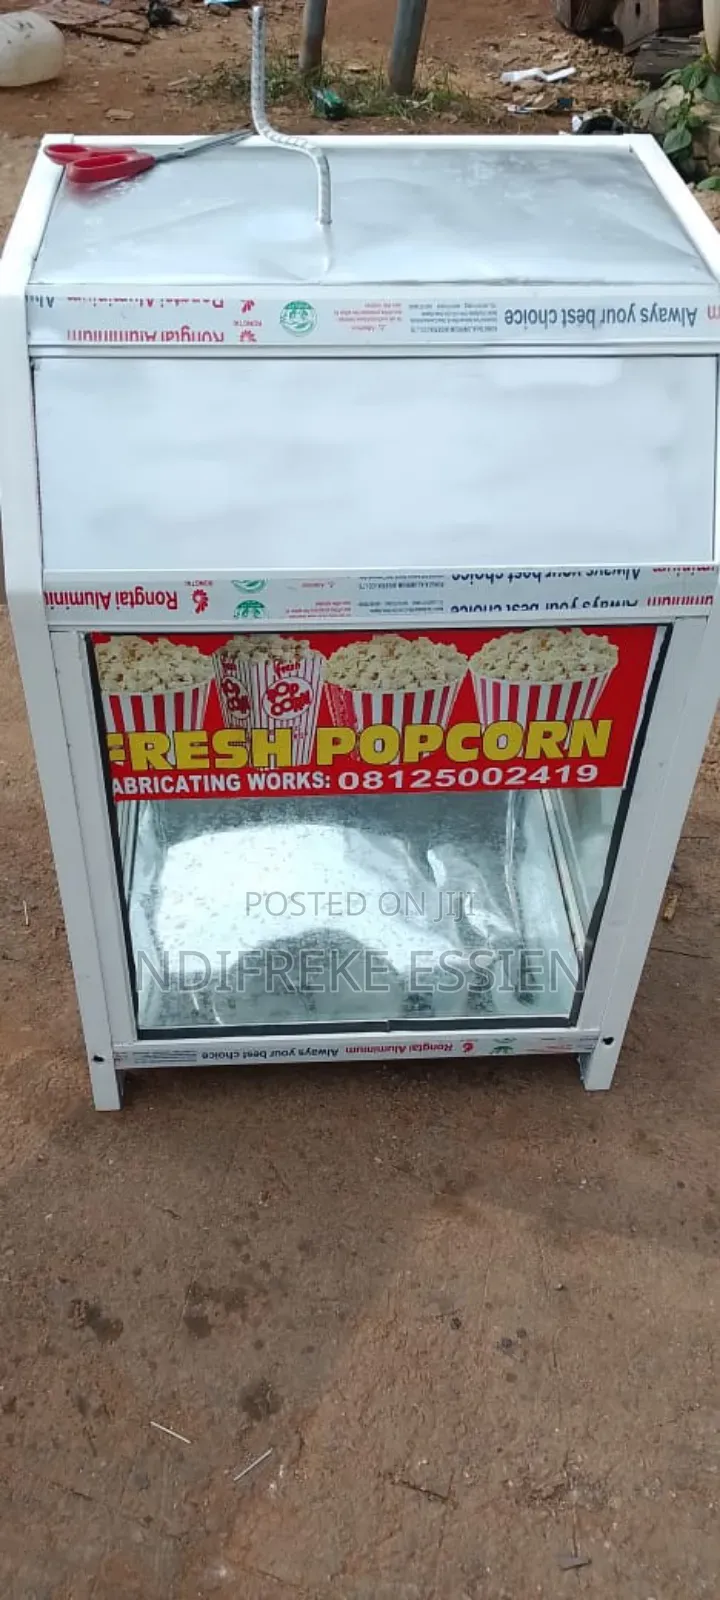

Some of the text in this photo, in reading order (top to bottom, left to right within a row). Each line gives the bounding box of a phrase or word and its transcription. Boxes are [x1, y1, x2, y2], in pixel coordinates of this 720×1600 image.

[504, 307, 558, 330] choice
[561, 306, 596, 328] best
[602, 302, 637, 325] your
[640, 303, 698, 328] Always
[116, 586, 178, 611] Rongtai
[106, 719, 612, 770] FRESH POPCORN
[246, 771, 331, 791] WORKS:
[338, 764, 599, 791] 08125002419
[201, 1049, 240, 1061] choice
[242, 1049, 268, 1060] best
[269, 1048, 296, 1060] your
[298, 1046, 339, 1058] Always
